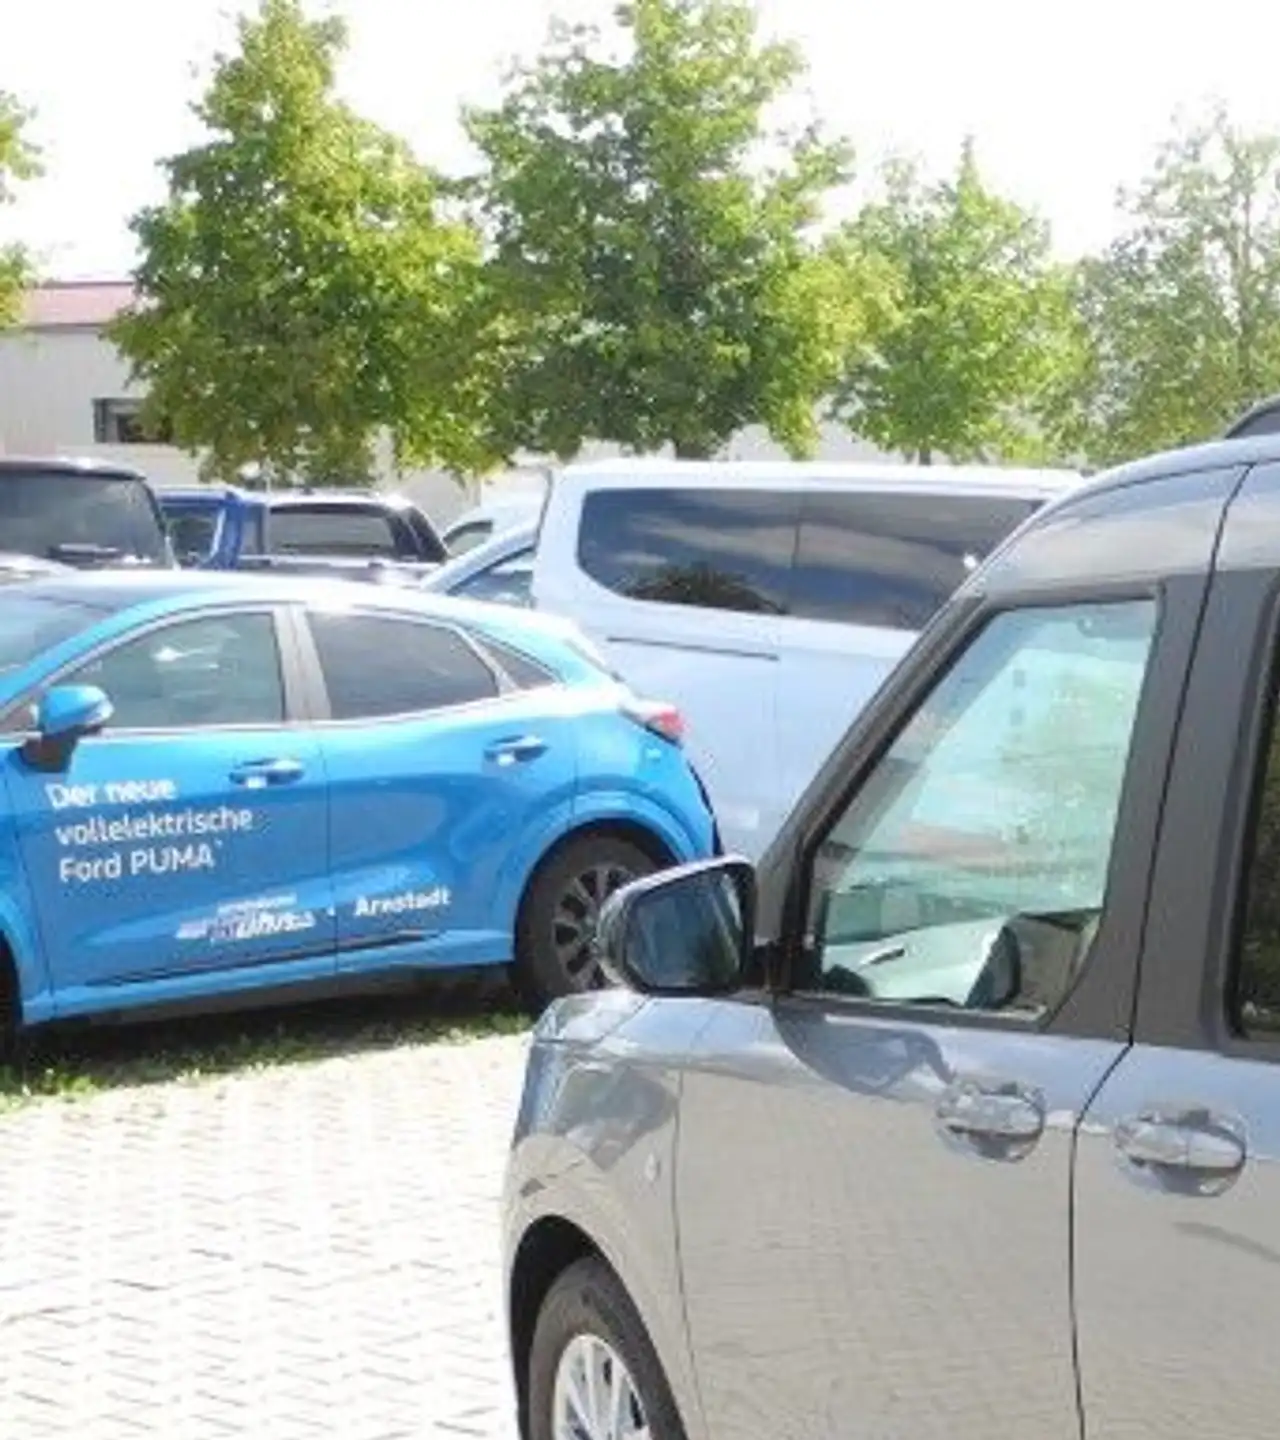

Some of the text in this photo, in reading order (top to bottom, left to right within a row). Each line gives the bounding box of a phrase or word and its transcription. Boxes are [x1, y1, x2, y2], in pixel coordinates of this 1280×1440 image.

[44, 777, 176, 809] Der neue
[55, 806, 254, 846] vollelektrische
[58, 852, 122, 884] Ford
